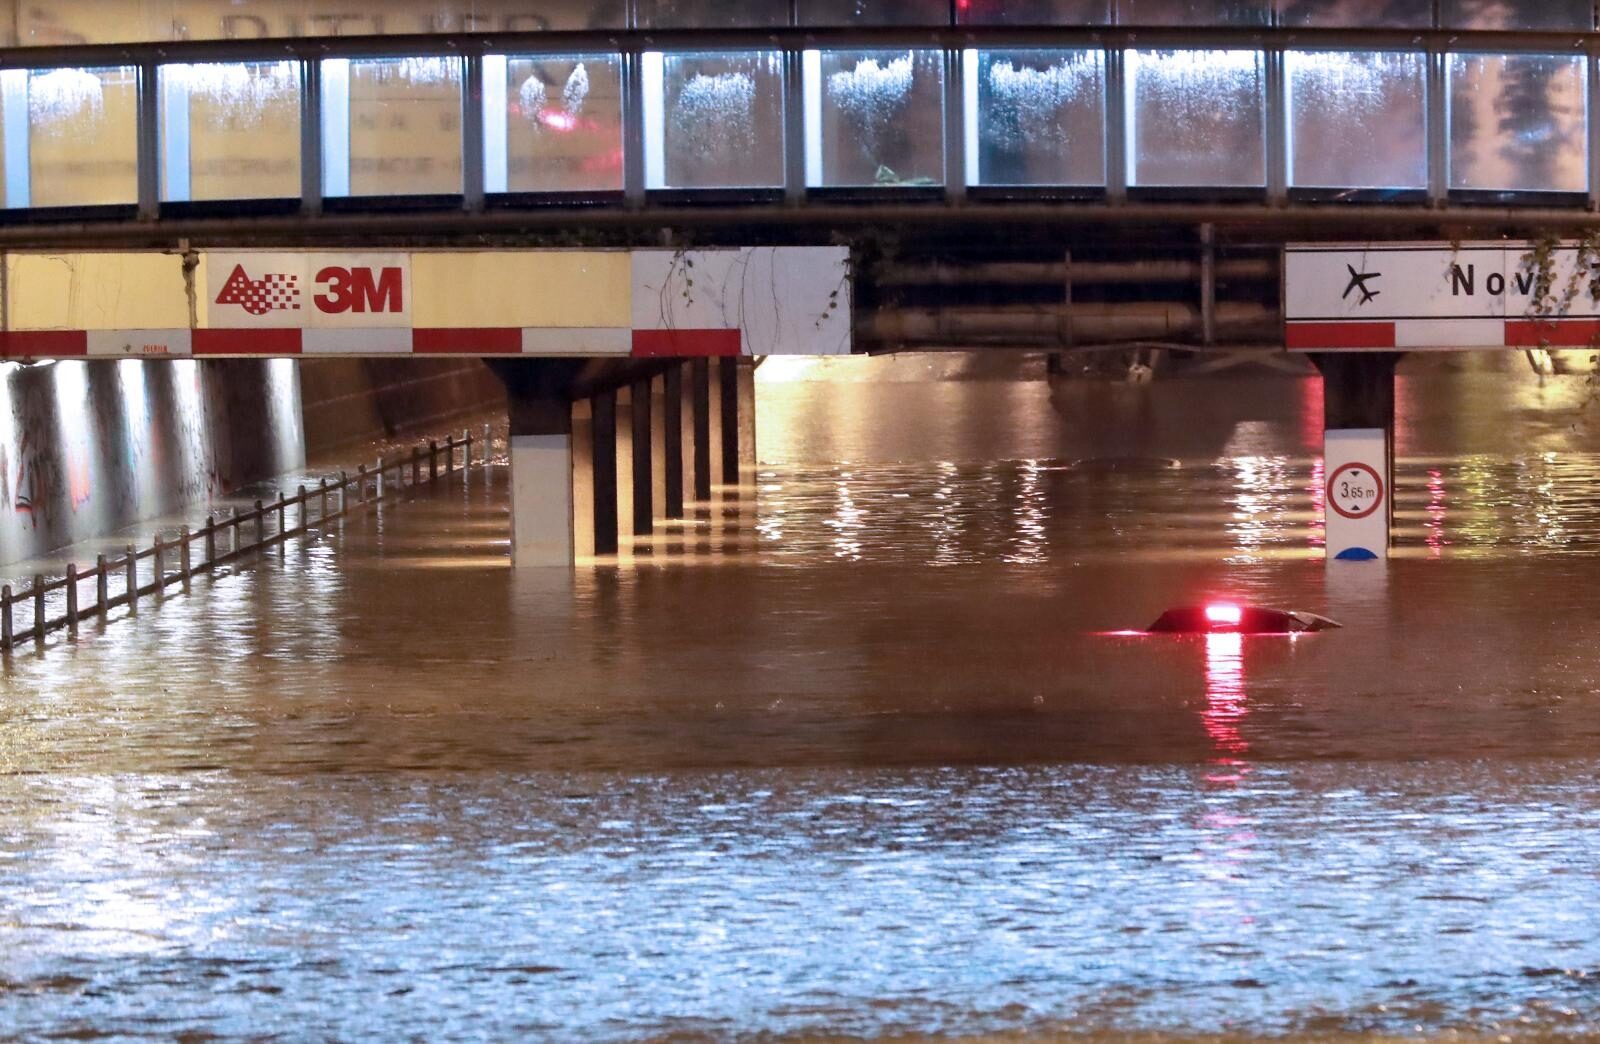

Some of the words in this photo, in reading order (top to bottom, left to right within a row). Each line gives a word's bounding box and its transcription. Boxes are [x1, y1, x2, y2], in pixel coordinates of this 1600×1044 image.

[314, 266, 403, 314] 3M
[1451, 262, 1540, 296] Nov
[1365, 489, 1376, 498] m
